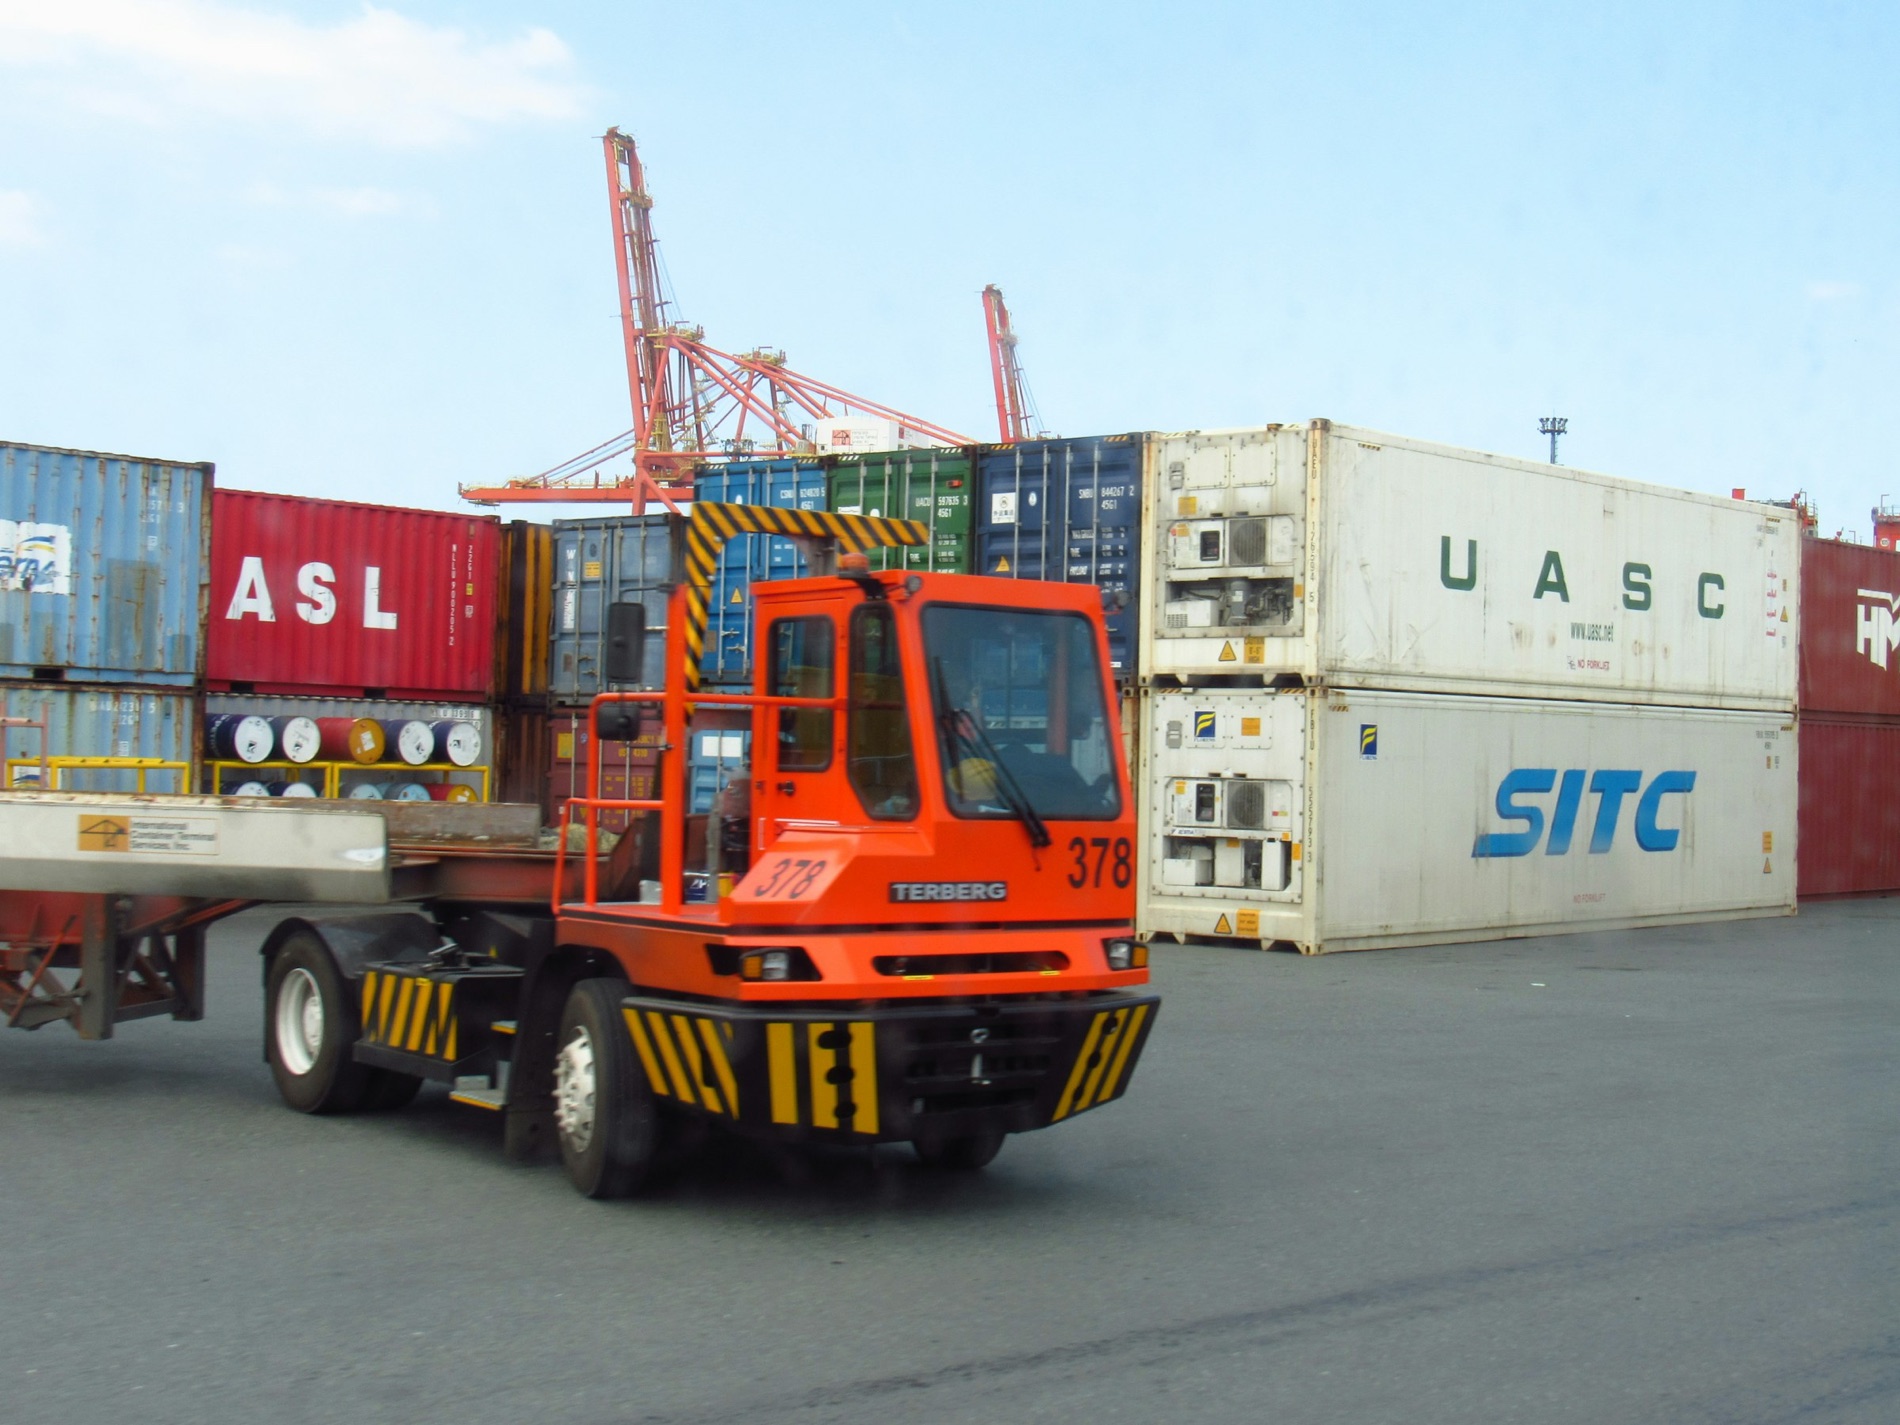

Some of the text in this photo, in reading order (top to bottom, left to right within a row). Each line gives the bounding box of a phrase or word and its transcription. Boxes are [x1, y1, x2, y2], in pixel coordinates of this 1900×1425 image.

[1129, 485, 1135, 496] 2
[225, 556, 397, 630] ASL
[1441, 535, 1724, 619] UASC
[1577, 659, 1585, 669] NO
[1470, 769, 1697, 858] SITC
[755, 858, 827, 899] 378
[1068, 837, 1131, 889] 378
[891, 882, 1007, 902] TERBERG
